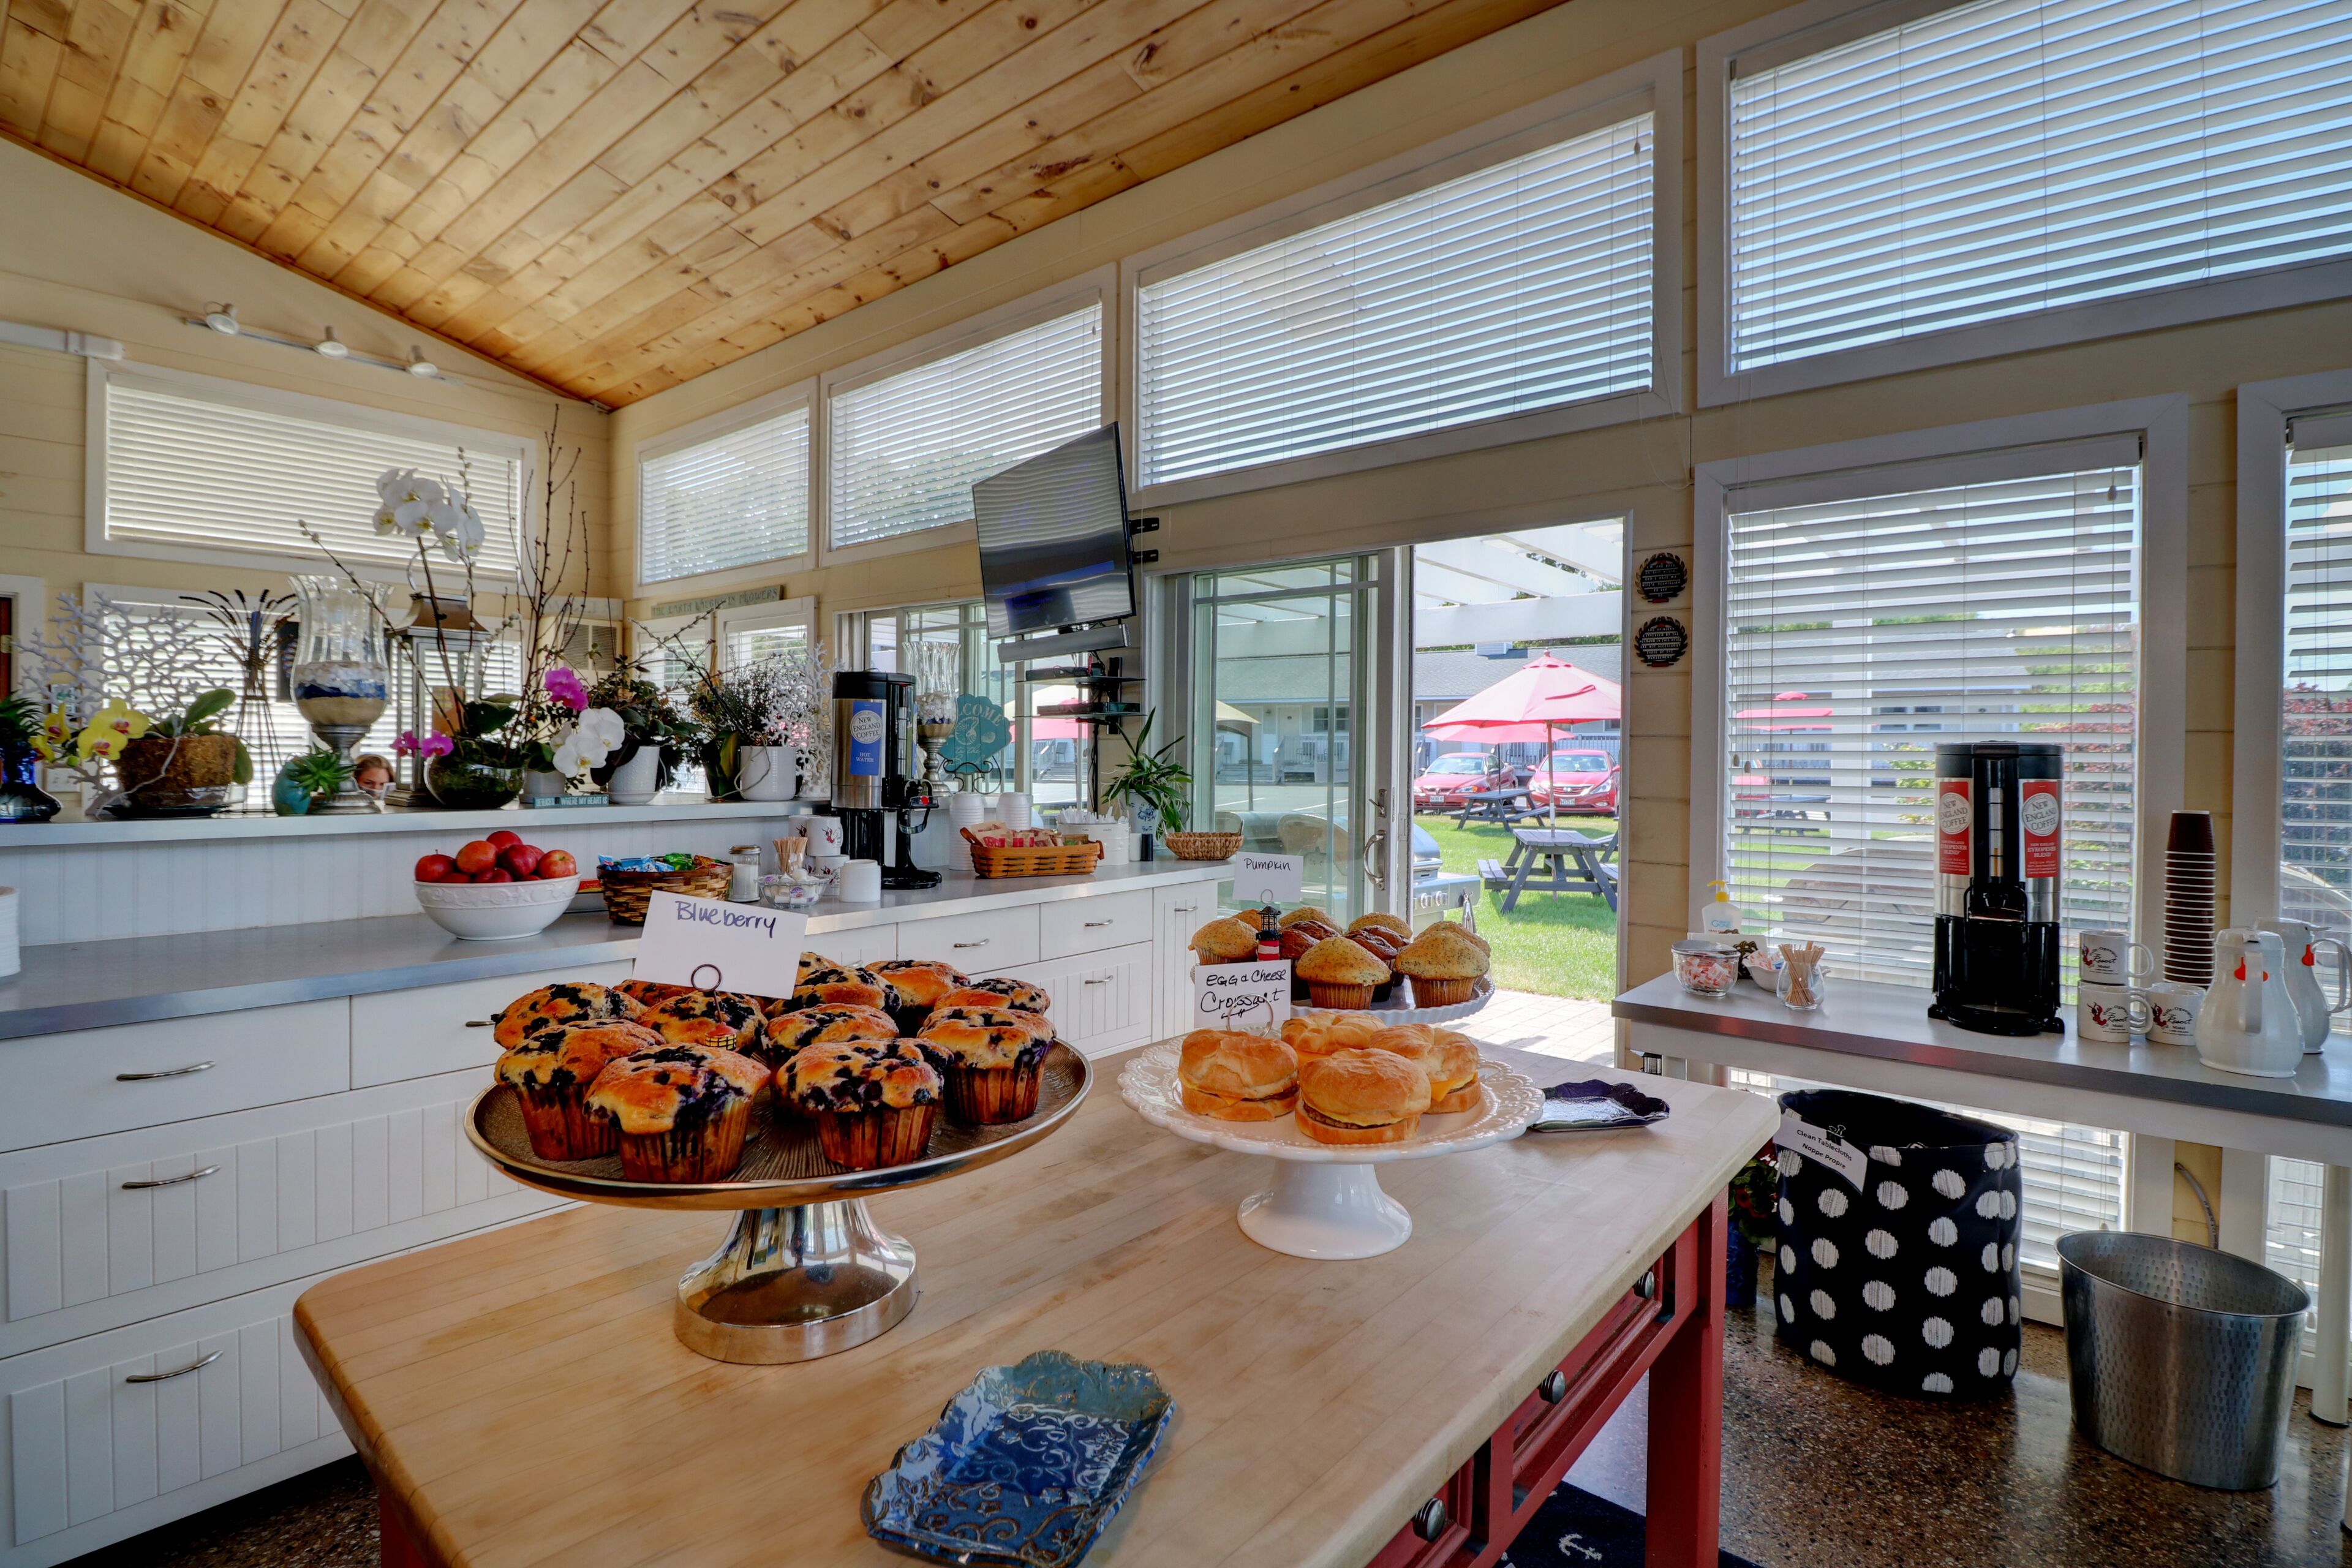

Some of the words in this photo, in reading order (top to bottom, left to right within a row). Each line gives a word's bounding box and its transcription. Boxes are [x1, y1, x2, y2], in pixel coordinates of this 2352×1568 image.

[739, 588, 777, 604] FLOWERS
[959, 702, 1003, 727] COME
[853, 723, 880, 732] ENGLAND
[856, 730, 880, 739] COFFEE
[560, 797, 578, 805] WHERE
[1943, 800, 1956, 809] NEW
[2032, 801, 2049, 810] NEW
[2025, 808, 2057, 822] ENGLAND
[1942, 816, 1968, 828] COFFEE
[2031, 818, 2057, 831] COFFEE
[1243, 858, 1291, 872] Pumpkin
[675, 900, 776, 938] Blueberry
[1796, 1129, 1816, 1141] Clean
[1817, 1137, 1852, 1161] Tablecloths
[1802, 1143, 1823, 1157] Nappe
[1825, 1154, 1846, 1169] Propre
